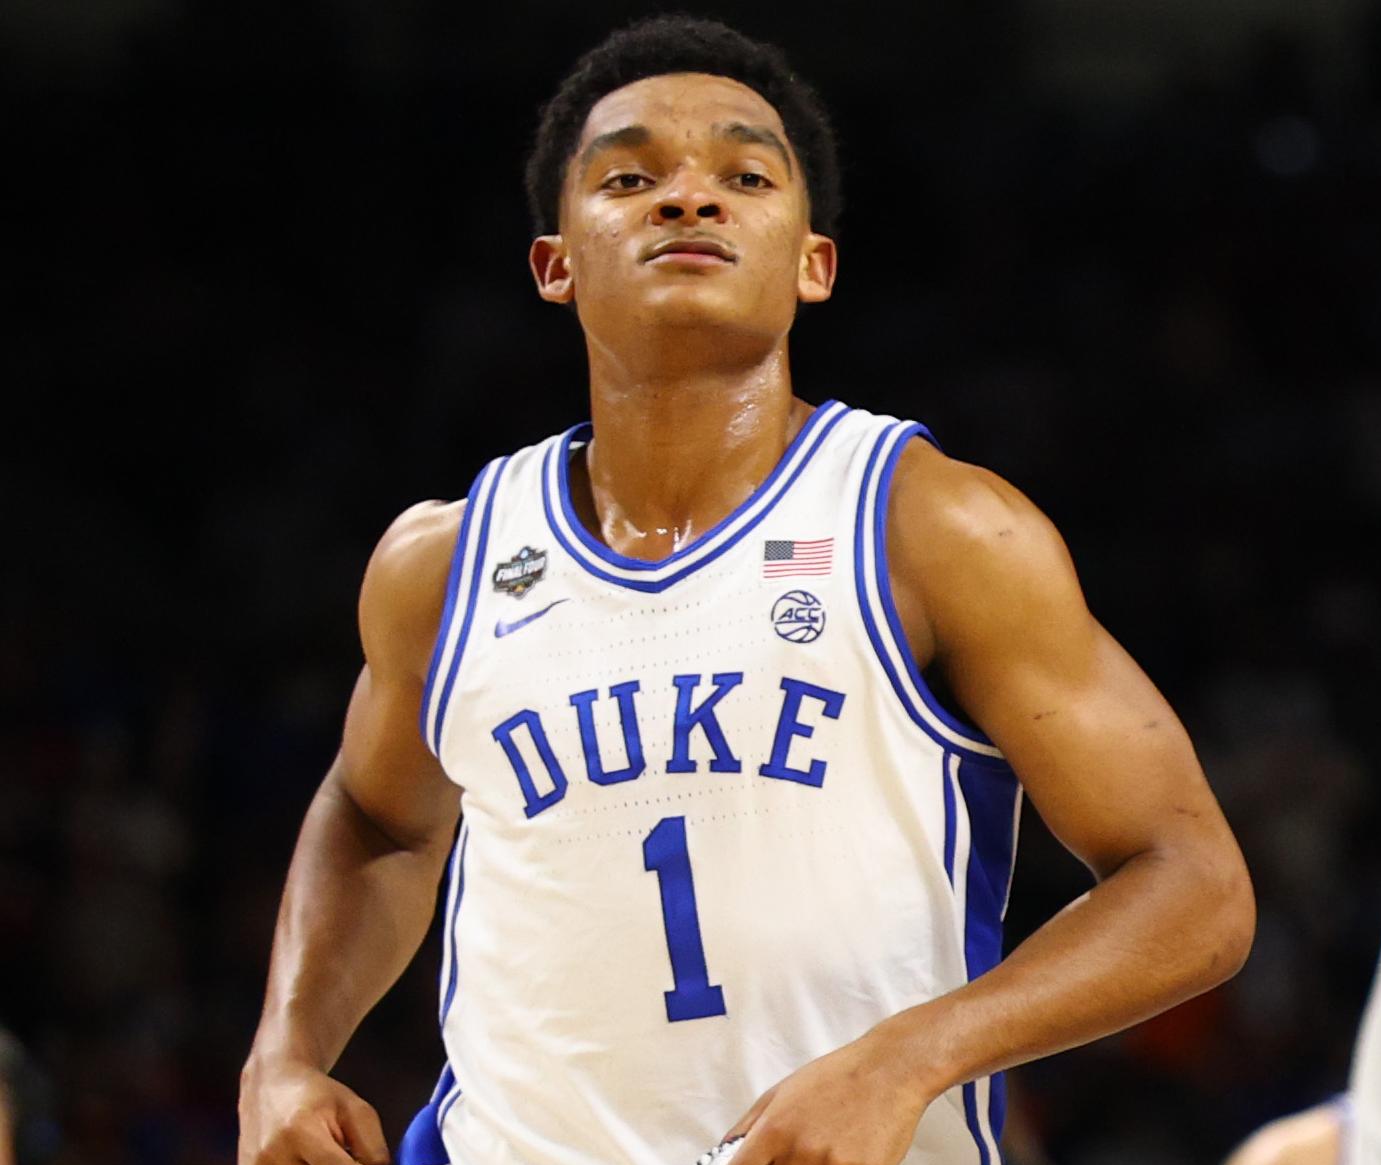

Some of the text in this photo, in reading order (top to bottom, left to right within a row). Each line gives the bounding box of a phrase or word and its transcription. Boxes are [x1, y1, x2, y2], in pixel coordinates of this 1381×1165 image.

[776, 607, 821, 624] ACC
[491, 671, 846, 819] DUKE
[642, 815, 727, 1023] 1
